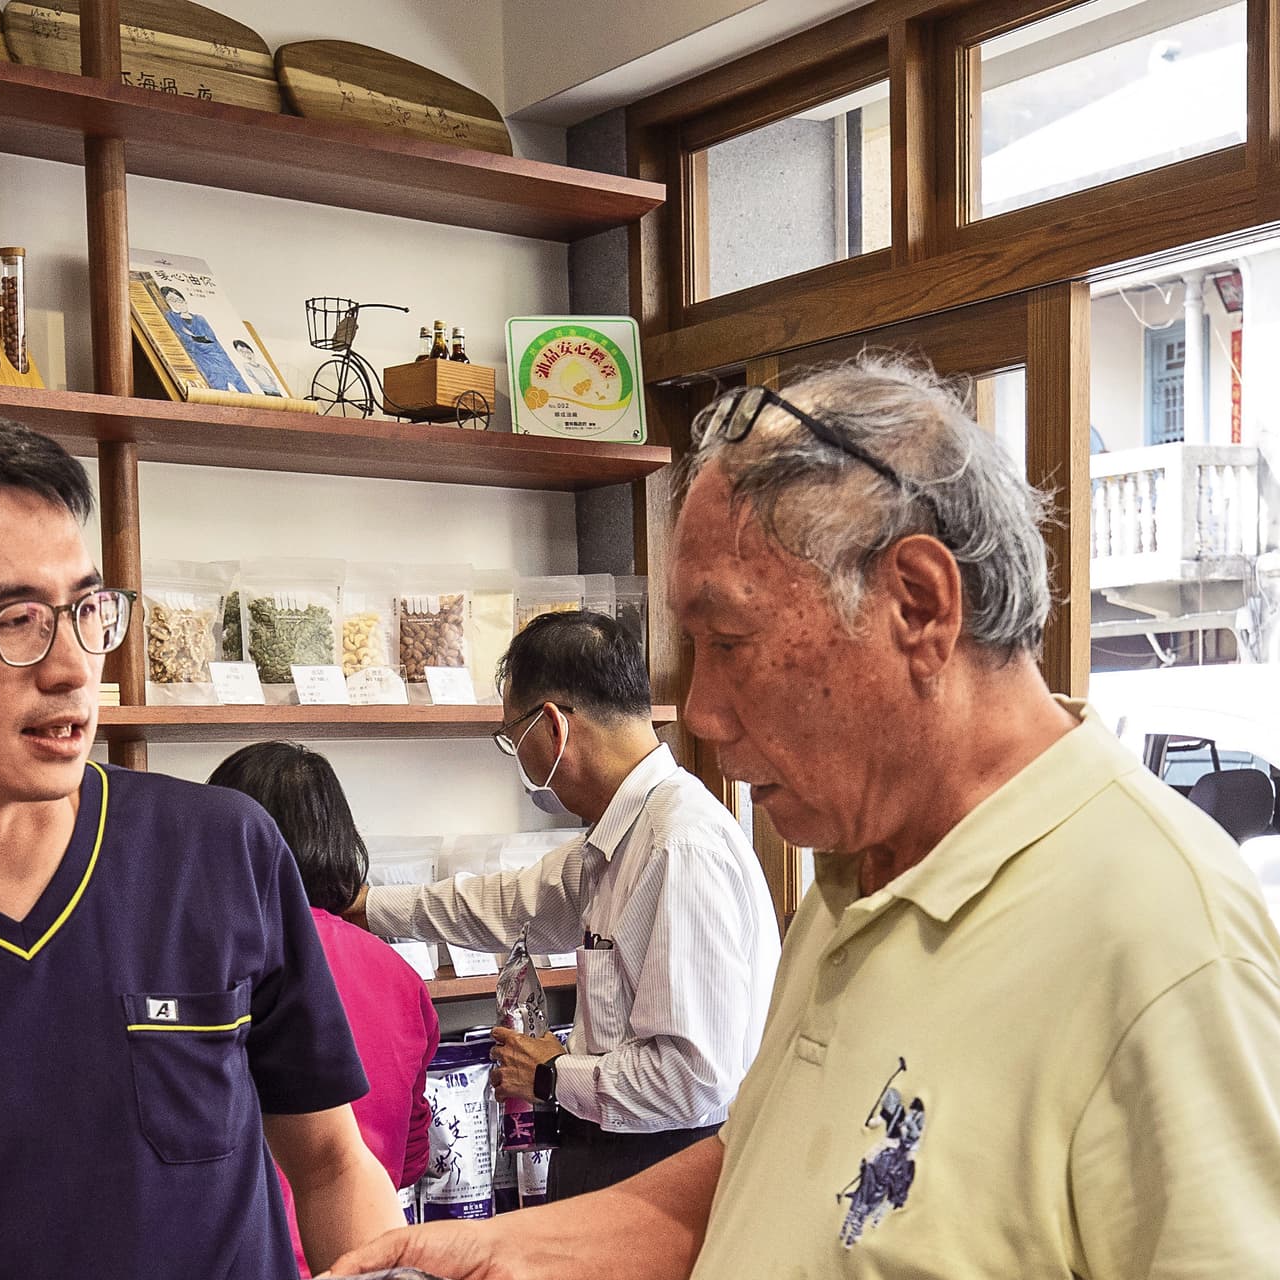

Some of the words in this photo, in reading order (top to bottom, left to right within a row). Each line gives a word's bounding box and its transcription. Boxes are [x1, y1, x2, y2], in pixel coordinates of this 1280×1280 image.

[535, 341, 617, 379] 油品安心標章
